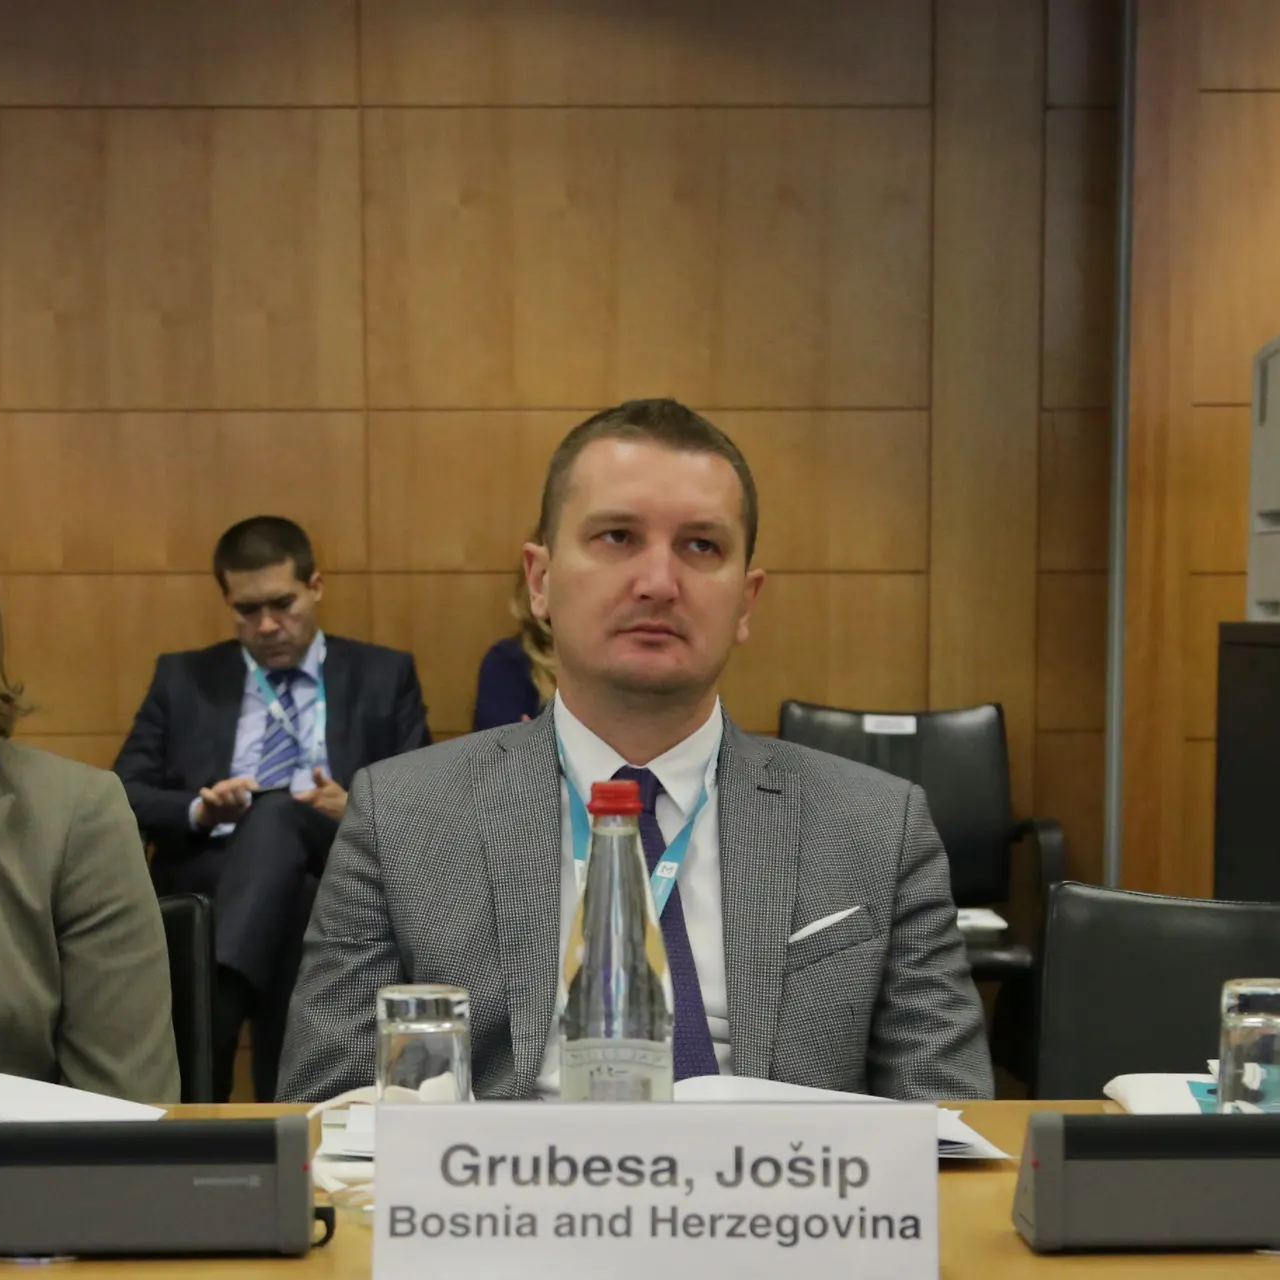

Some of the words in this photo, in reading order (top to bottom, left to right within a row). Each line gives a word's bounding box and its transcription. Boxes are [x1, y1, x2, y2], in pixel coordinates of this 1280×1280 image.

[440, 1143, 694, 1195] Grubesa,
[715, 1141, 870, 1199] Jošip
[389, 1205, 537, 1238] Bosnia
[553, 1205, 632, 1238] and
[650, 1205, 922, 1248] Herzegovina
